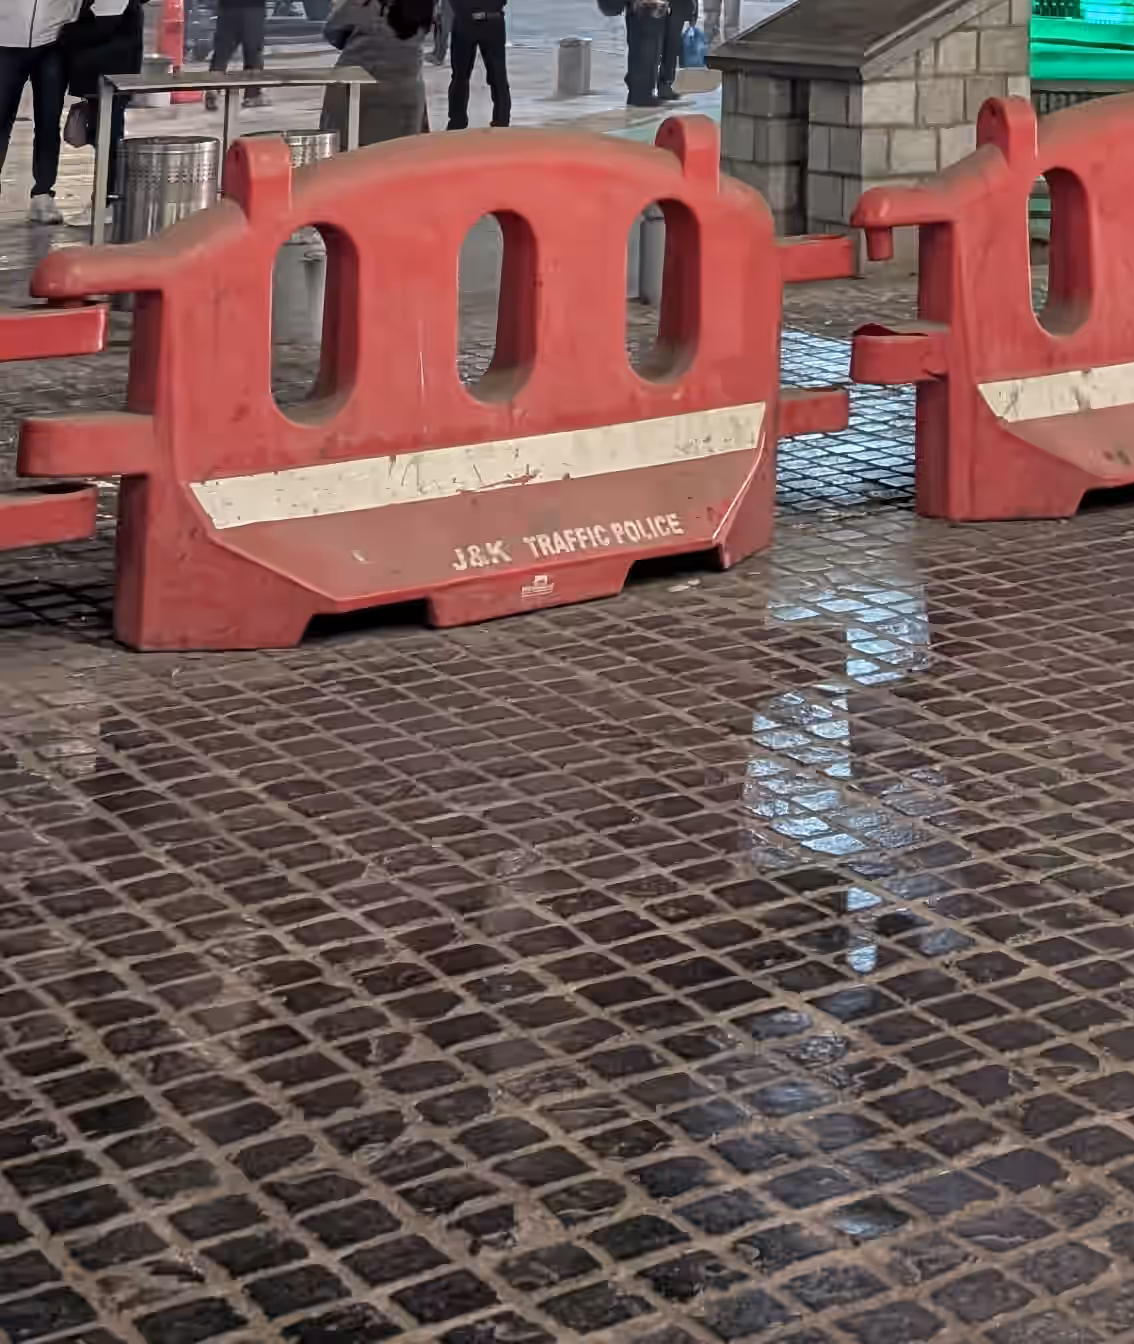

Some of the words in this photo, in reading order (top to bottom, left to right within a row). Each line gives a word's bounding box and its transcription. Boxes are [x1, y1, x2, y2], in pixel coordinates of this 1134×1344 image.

[452, 540, 513, 571] J&K
[523, 525, 611, 559] TRAFFIC
[610, 512, 685, 545] POLICE
